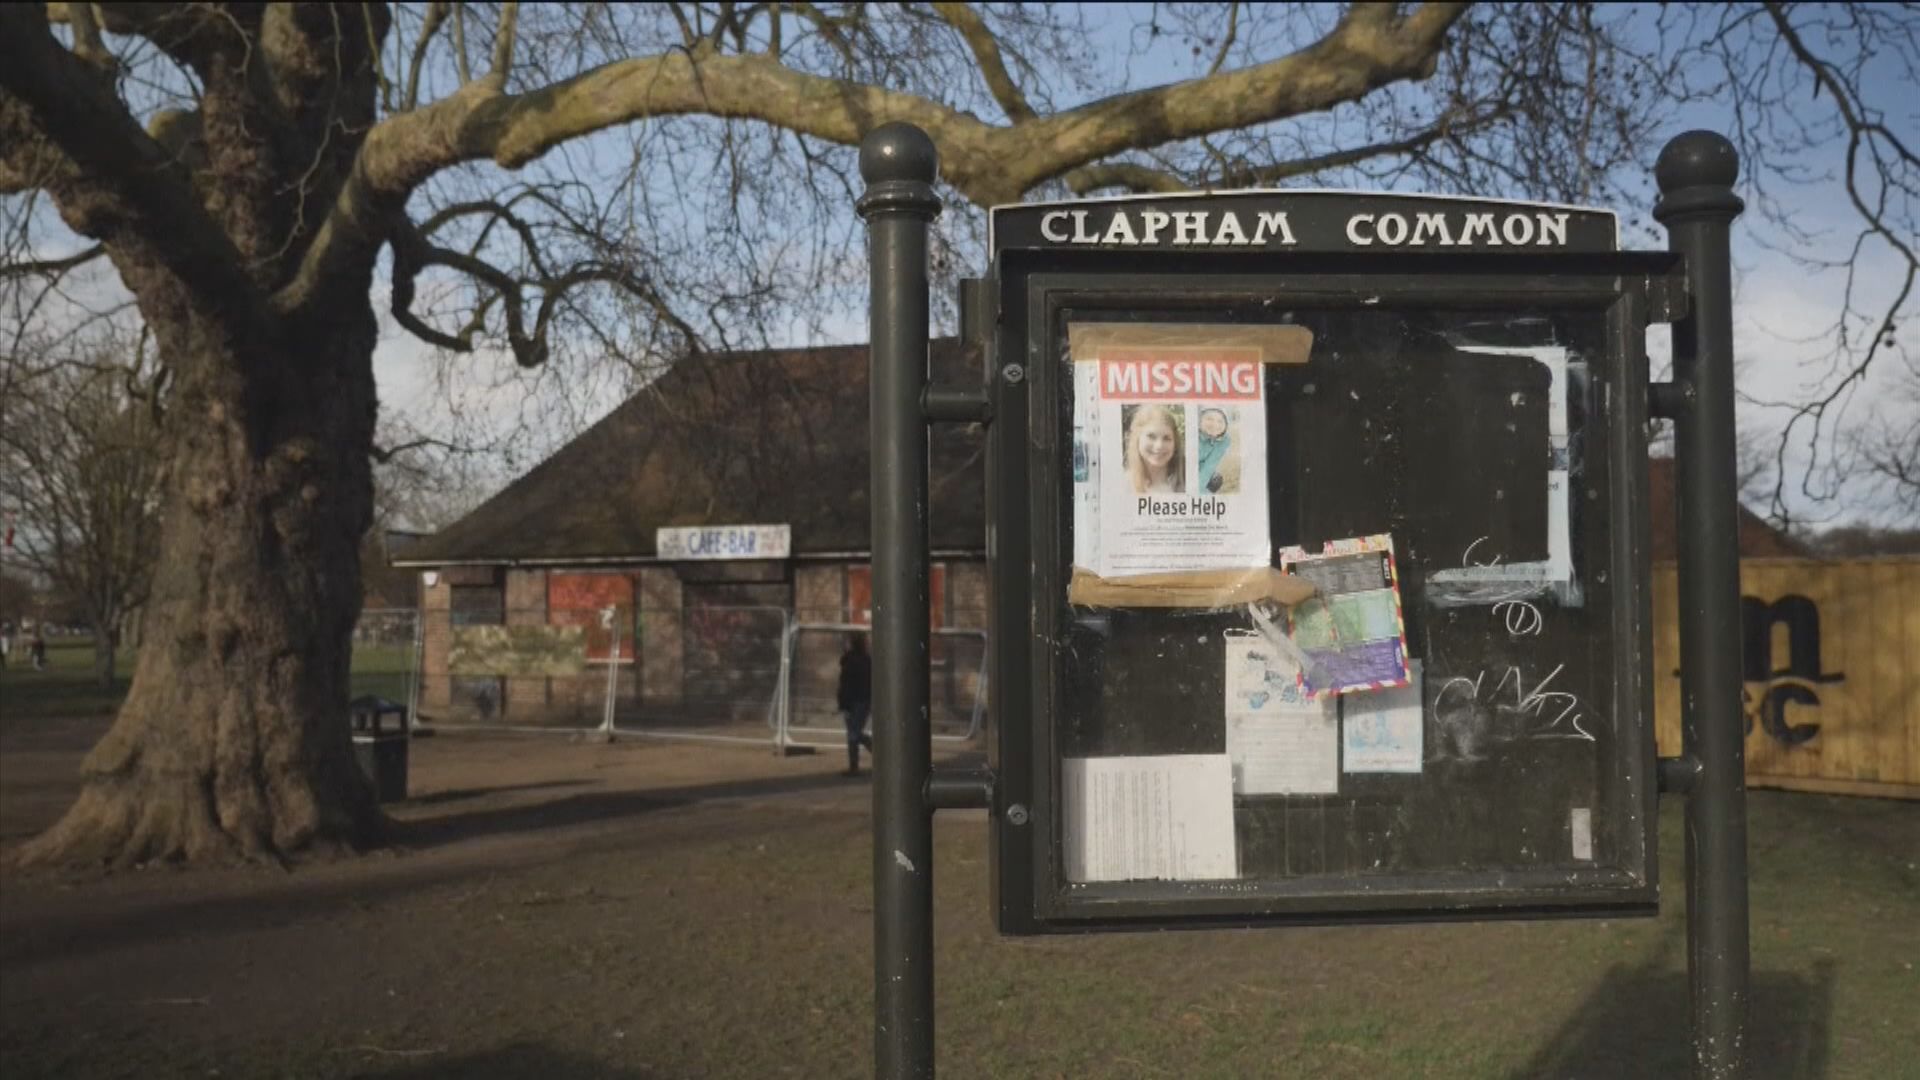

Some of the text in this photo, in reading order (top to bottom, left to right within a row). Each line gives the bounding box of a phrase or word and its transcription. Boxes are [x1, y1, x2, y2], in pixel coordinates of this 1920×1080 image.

[1040, 211, 1570, 246] CLAPHAM COMMON
[1107, 362, 1256, 394] MISSING
[1138, 497, 1226, 520] Please Help
